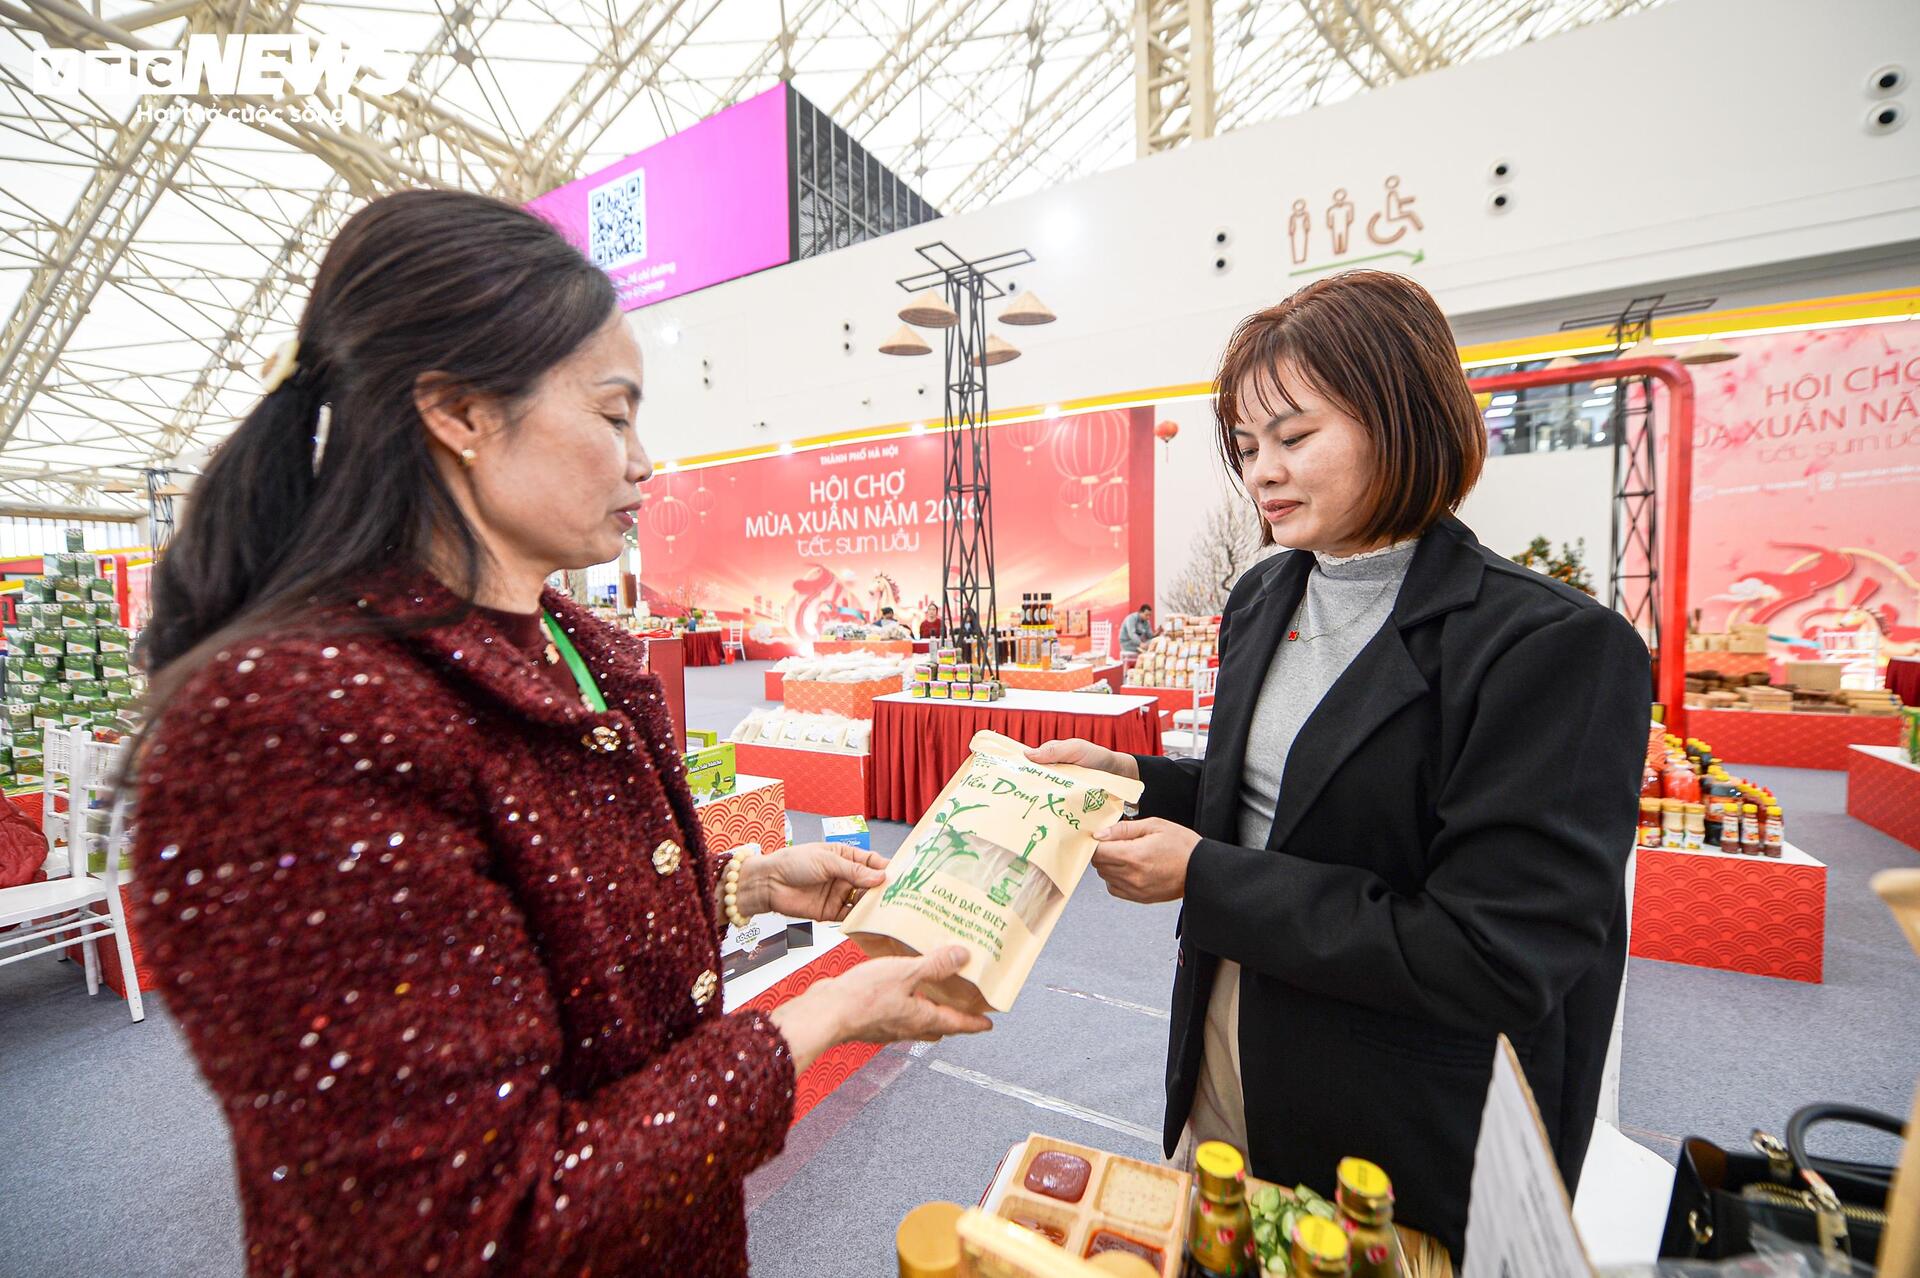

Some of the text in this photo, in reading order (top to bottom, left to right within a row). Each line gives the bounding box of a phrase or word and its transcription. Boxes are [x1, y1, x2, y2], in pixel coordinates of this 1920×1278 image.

[882, 444, 899, 458] NỘI
[810, 468, 905, 505] HỘI CHỢ
[745, 511, 793, 538] MÙA
[797, 503, 859, 534] XUÂN
[864, 499, 919, 529] NĂM
